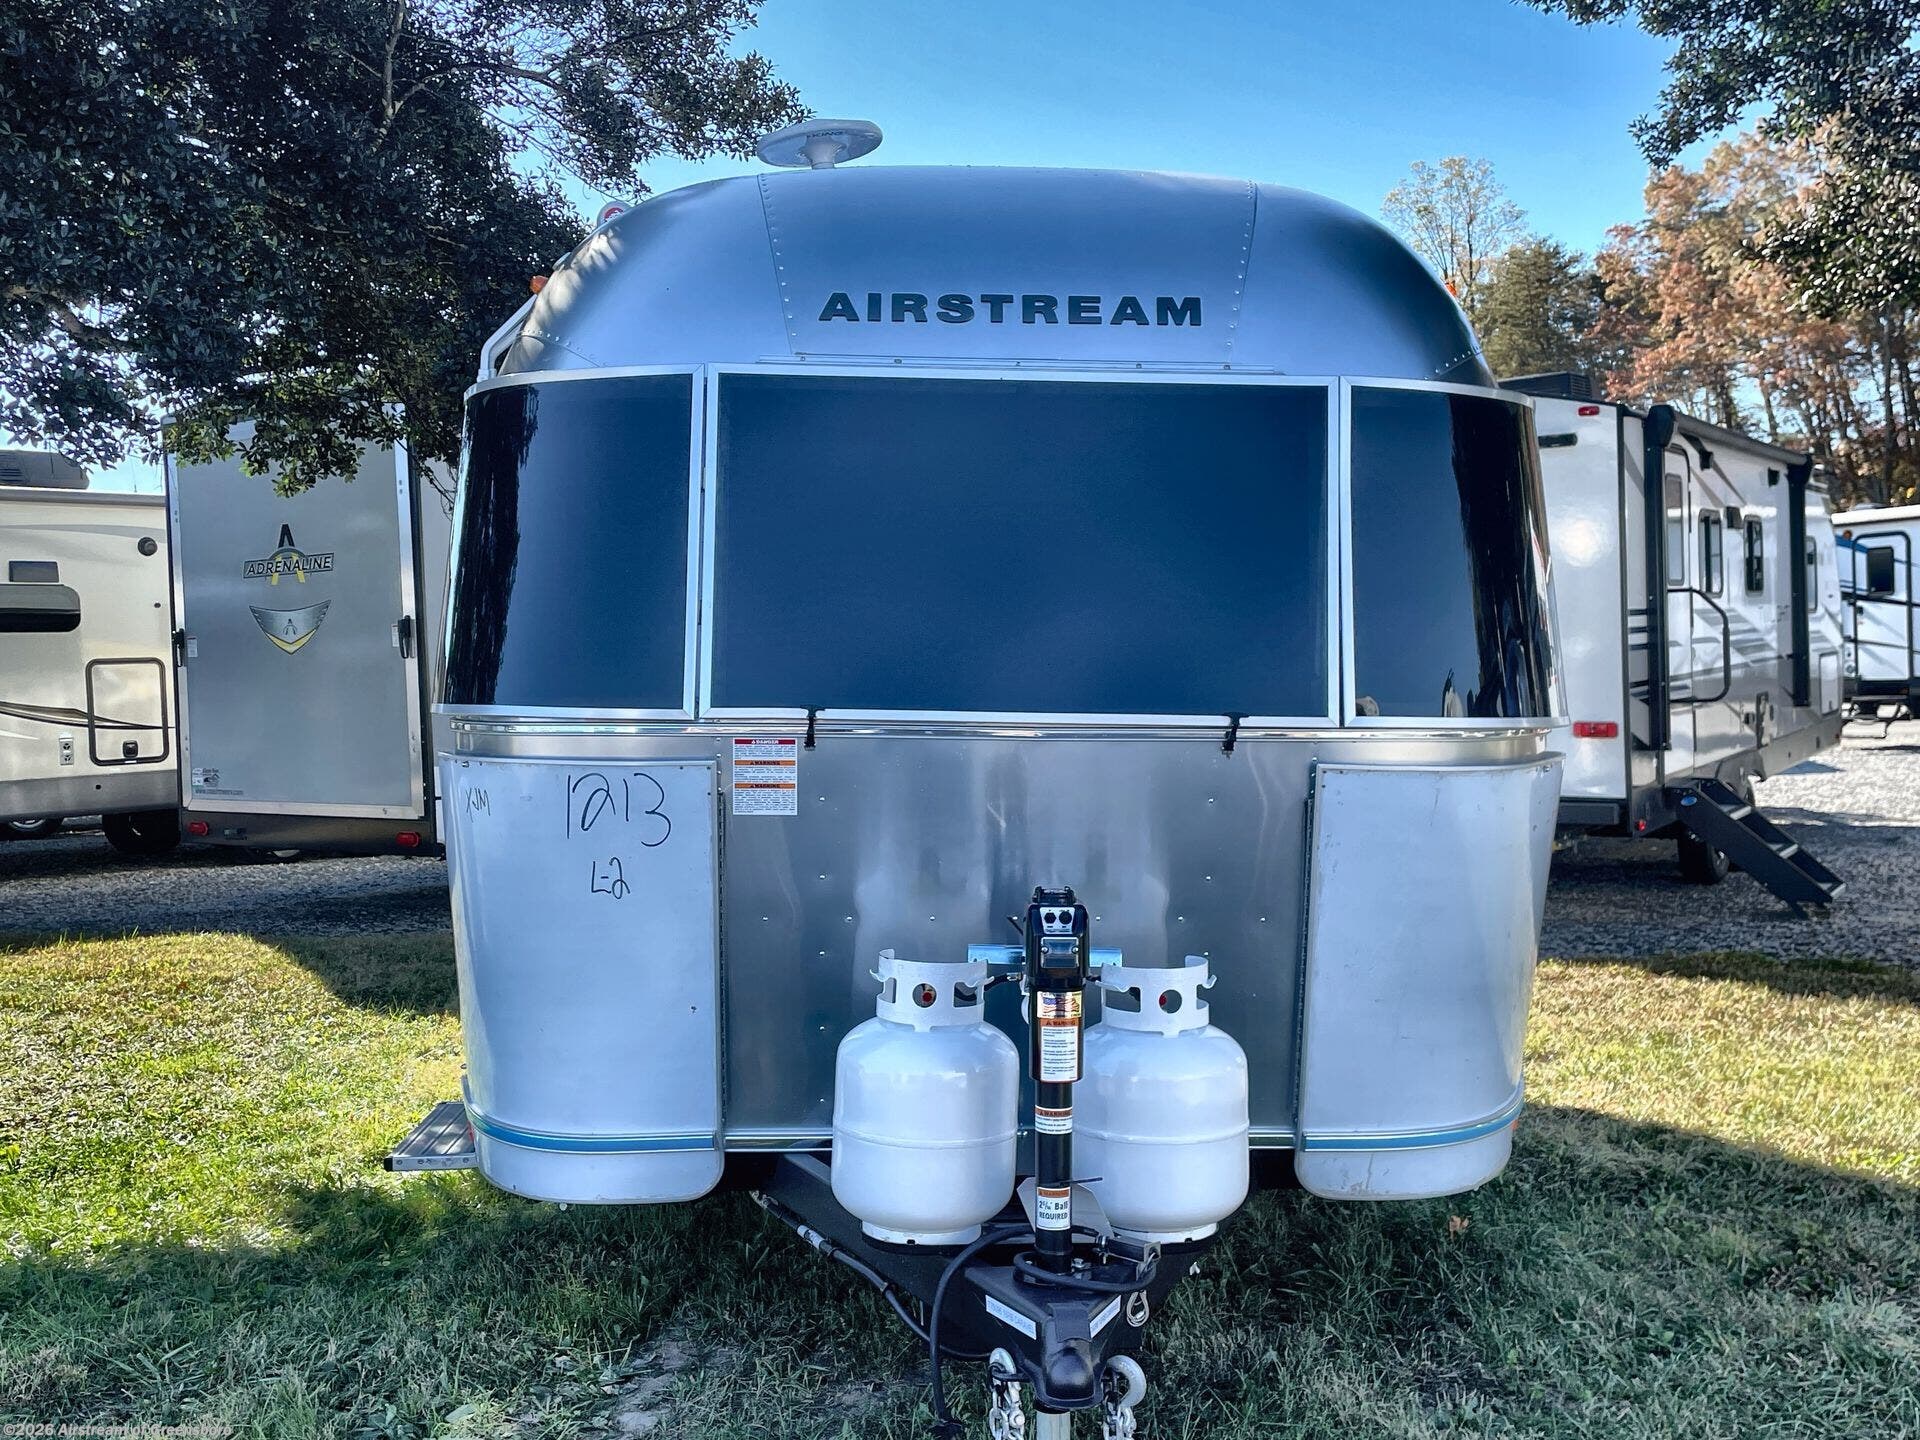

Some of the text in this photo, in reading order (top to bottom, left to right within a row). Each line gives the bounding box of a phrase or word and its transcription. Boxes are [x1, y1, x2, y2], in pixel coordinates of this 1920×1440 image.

[818, 292, 1202, 326] AIRSTREAM
[246, 556, 332, 576] ADRENALINE
[566, 773, 672, 847] 1213
[591, 857, 631, 899] L-2
[1039, 1211, 1068, 1220] REQUIRED
[1054, 1200, 1069, 1210] Ball
